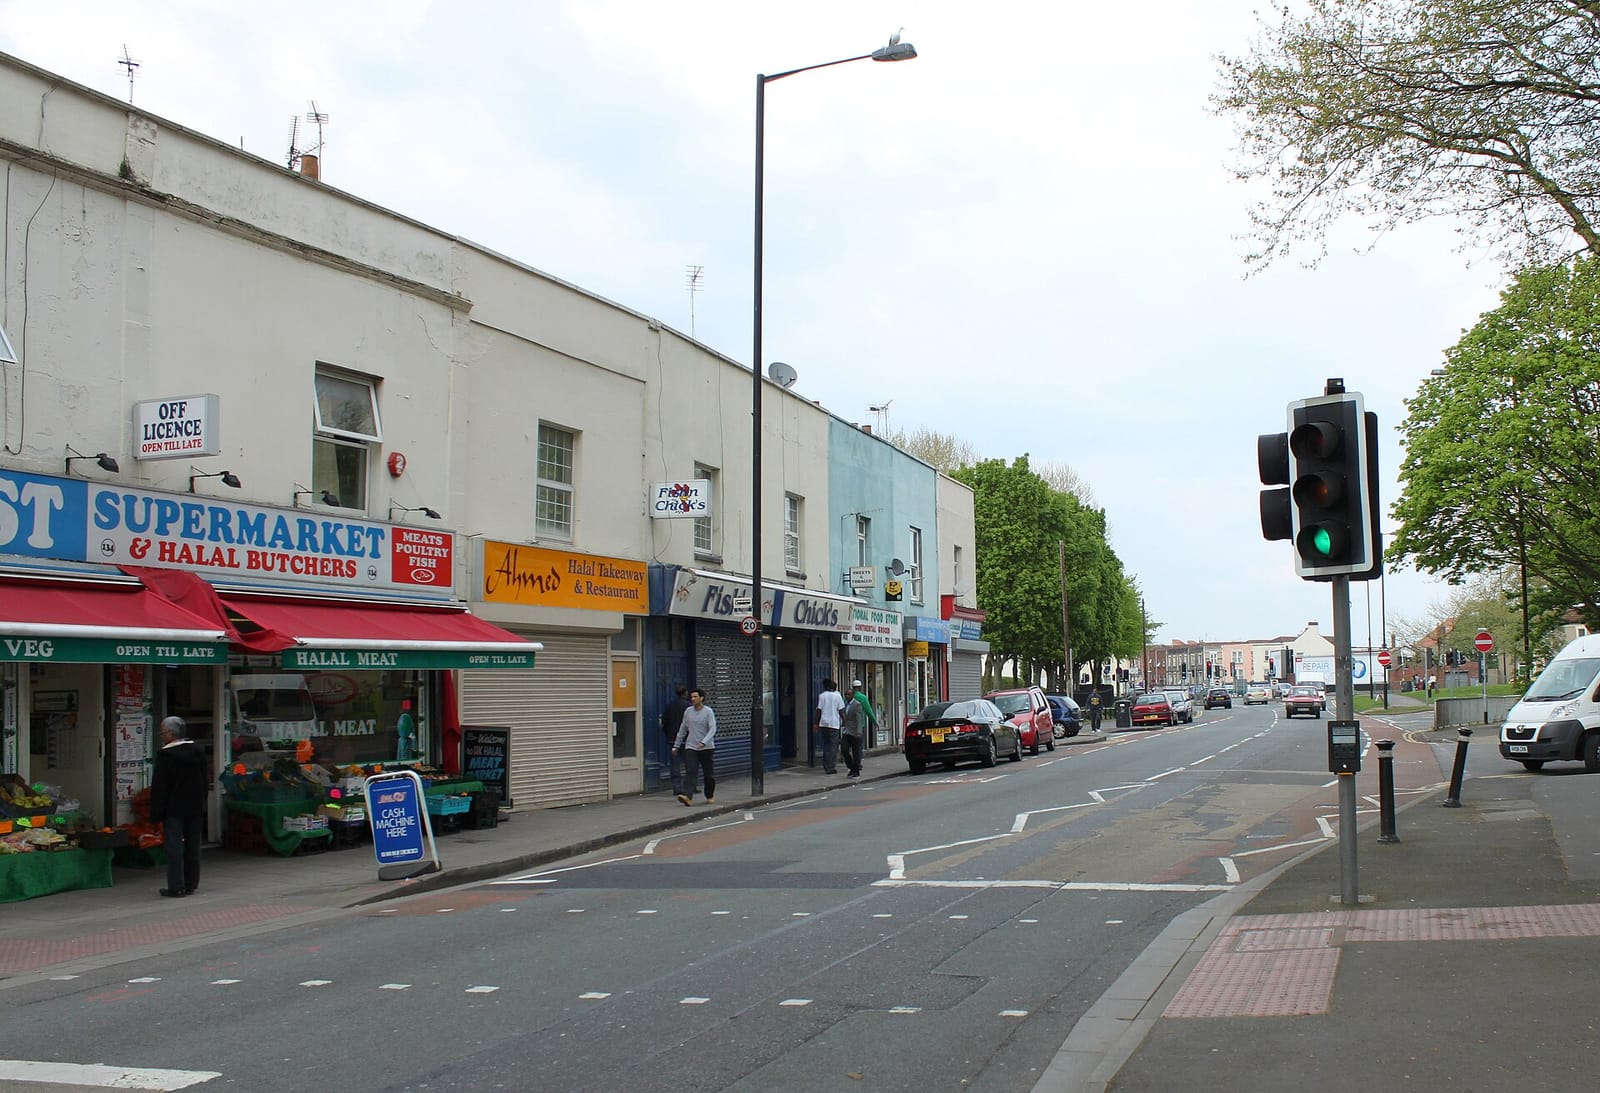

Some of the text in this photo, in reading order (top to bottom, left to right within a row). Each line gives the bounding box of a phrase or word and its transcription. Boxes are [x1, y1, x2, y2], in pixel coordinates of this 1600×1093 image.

[159, 401, 187, 419] OFF
[144, 419, 202, 440] LICENCE
[142, 439, 202, 452] OPEN TILL LATE
[94, 490, 385, 559] SUPERMARKET
[402, 532, 443, 546] MEATS
[102, 543, 114, 552] 134
[396, 542, 449, 558] POULTRY
[130, 537, 357, 578] & HALAL BUTCHERS
[409, 556, 437, 568] FISH
[486, 548, 560, 600] Ahmed
[568, 559, 645, 585] Halal Takeaway
[574, 579, 639, 599] & Restaurant
[794, 599, 838, 626] Chick's
[871, 611, 884, 623] FOOD
[886, 613, 898, 625] STORE
[743, 621, 755, 630] 20
[4, 639, 215, 658] VEG OPEN TIL LATE
[296, 651, 527, 666] HALAL MEAT OPEN TIL LATE
[1303, 662, 1329, 671] REPAIR
[271, 719, 377, 738] HALAL MEAT
[469, 757, 504, 769] MEAT
[382, 808, 405, 819] CASH
[376, 816, 415, 829] MACHINE
[386, 827, 408, 838] HERE
